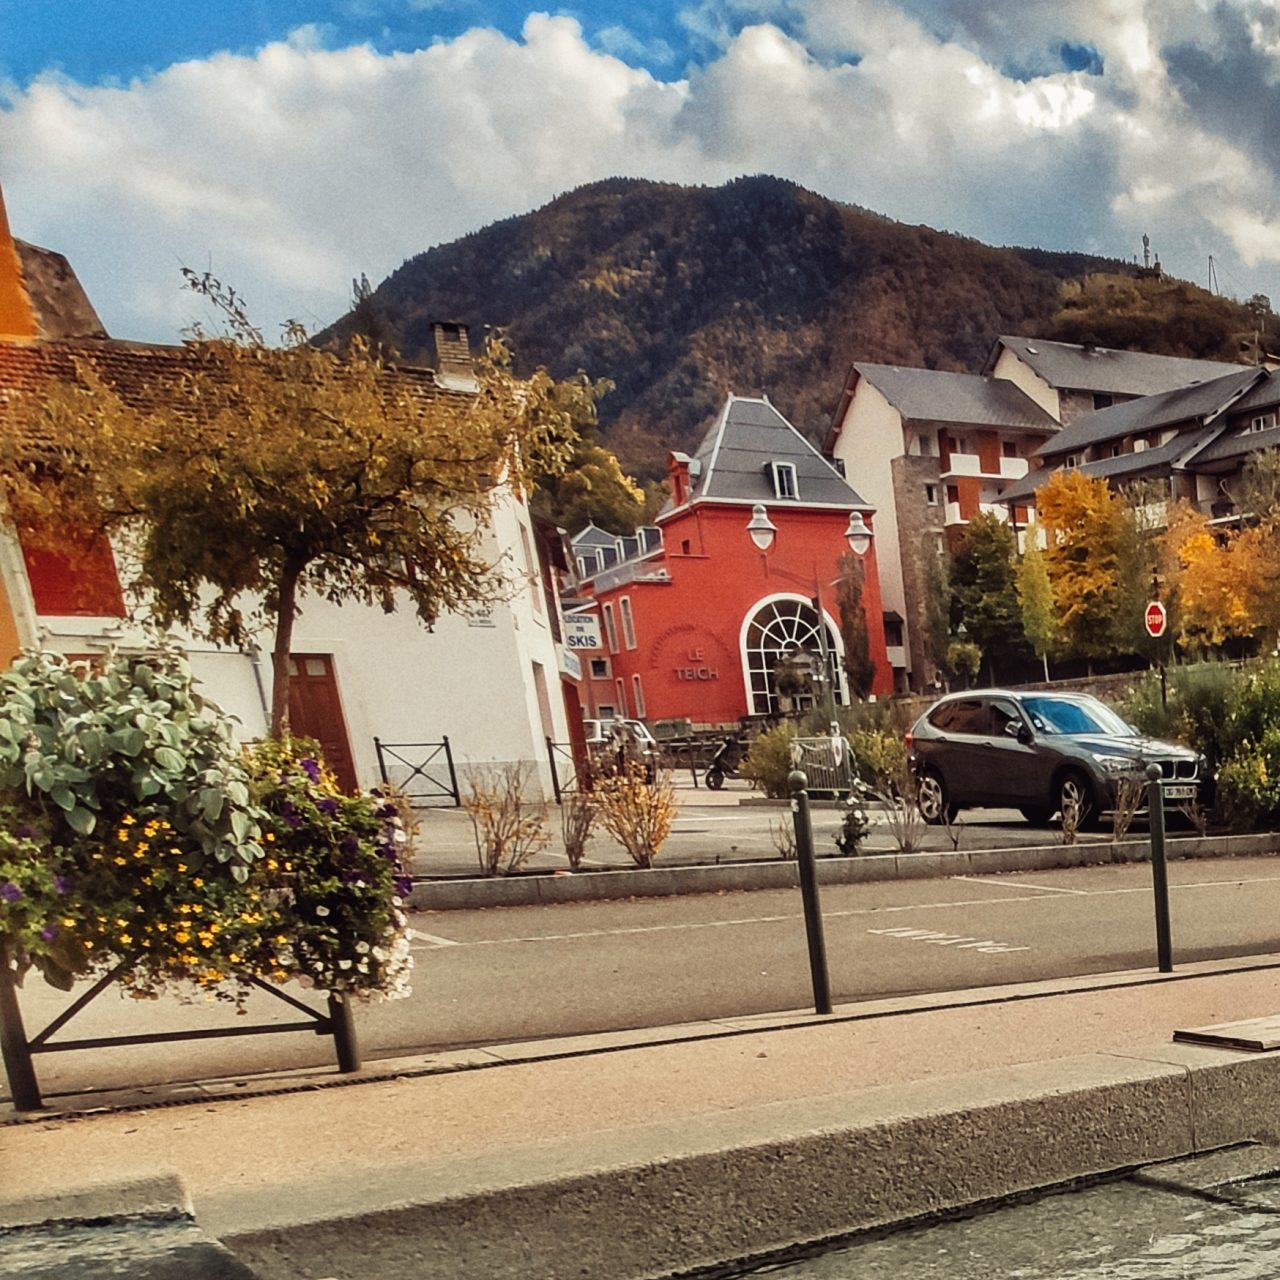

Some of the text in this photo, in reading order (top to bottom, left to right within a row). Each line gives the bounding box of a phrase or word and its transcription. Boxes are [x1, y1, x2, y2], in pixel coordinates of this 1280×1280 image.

[1147, 614, 1162, 624] STOP
[568, 635, 597, 648] SKIS
[688, 648, 704, 662] LE
[675, 666, 719, 681] TEICH
